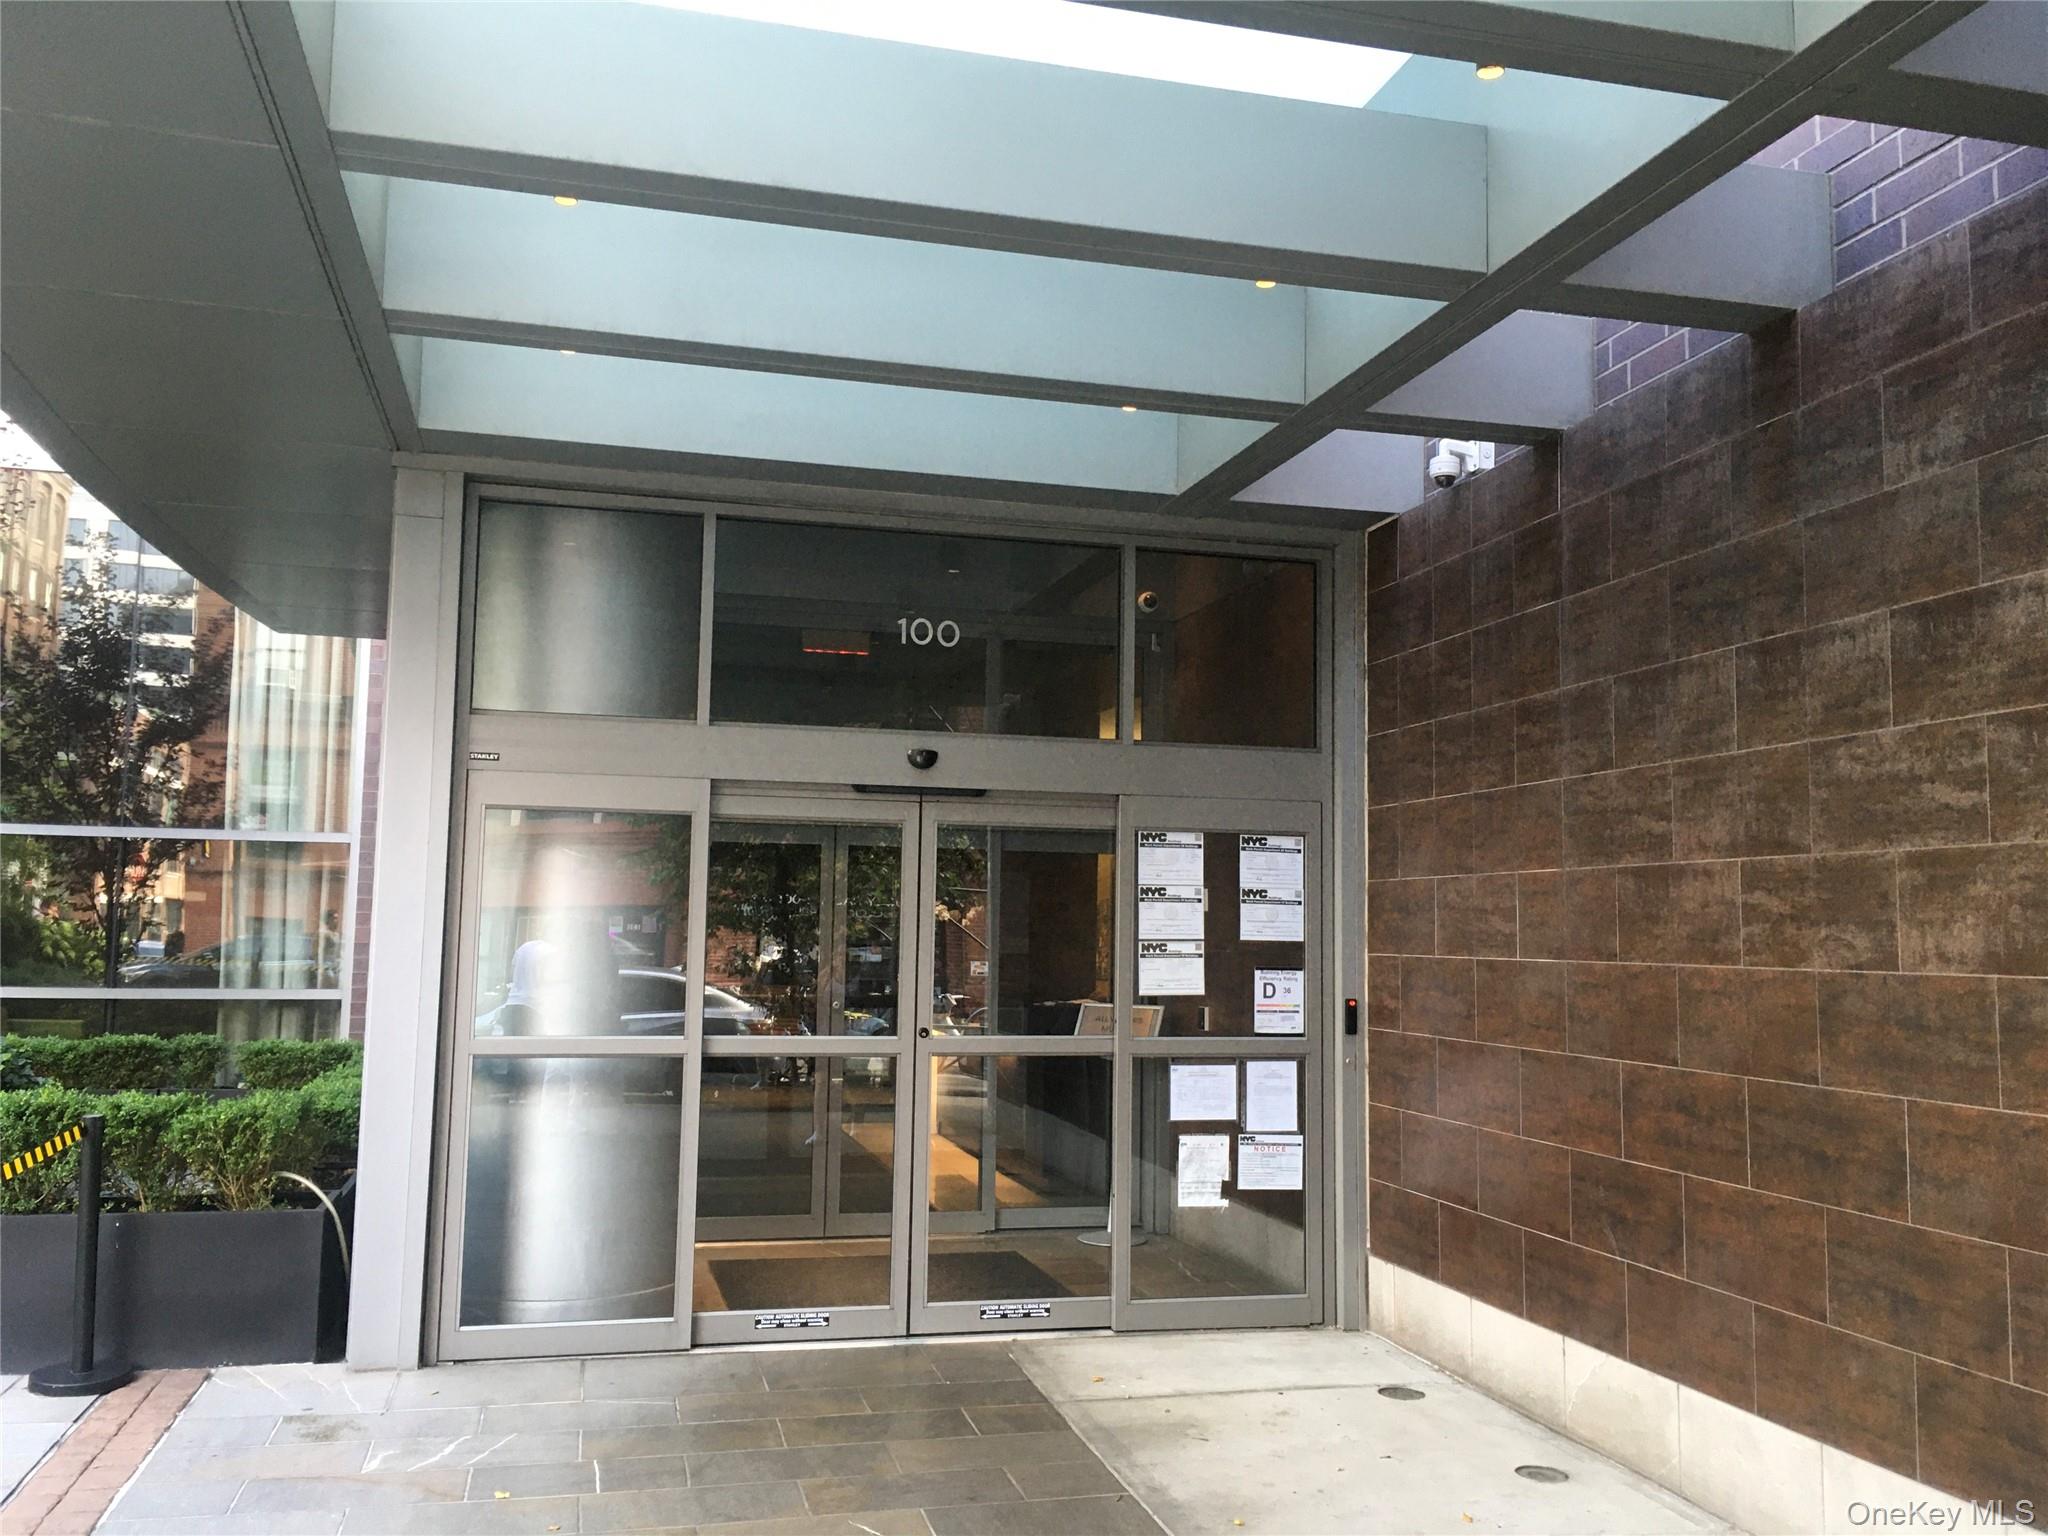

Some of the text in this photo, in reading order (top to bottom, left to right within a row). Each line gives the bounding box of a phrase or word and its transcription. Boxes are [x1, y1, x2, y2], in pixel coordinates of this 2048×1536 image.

[897, 617, 960, 647] 100
[1140, 832, 1168, 842] NYC
[1241, 836, 1268, 846] NYC
[1140, 887, 1167, 896] NYC
[1241, 888, 1268, 898] NYC
[1141, 943, 1168, 952] NYC
[1263, 982, 1276, 999] D
